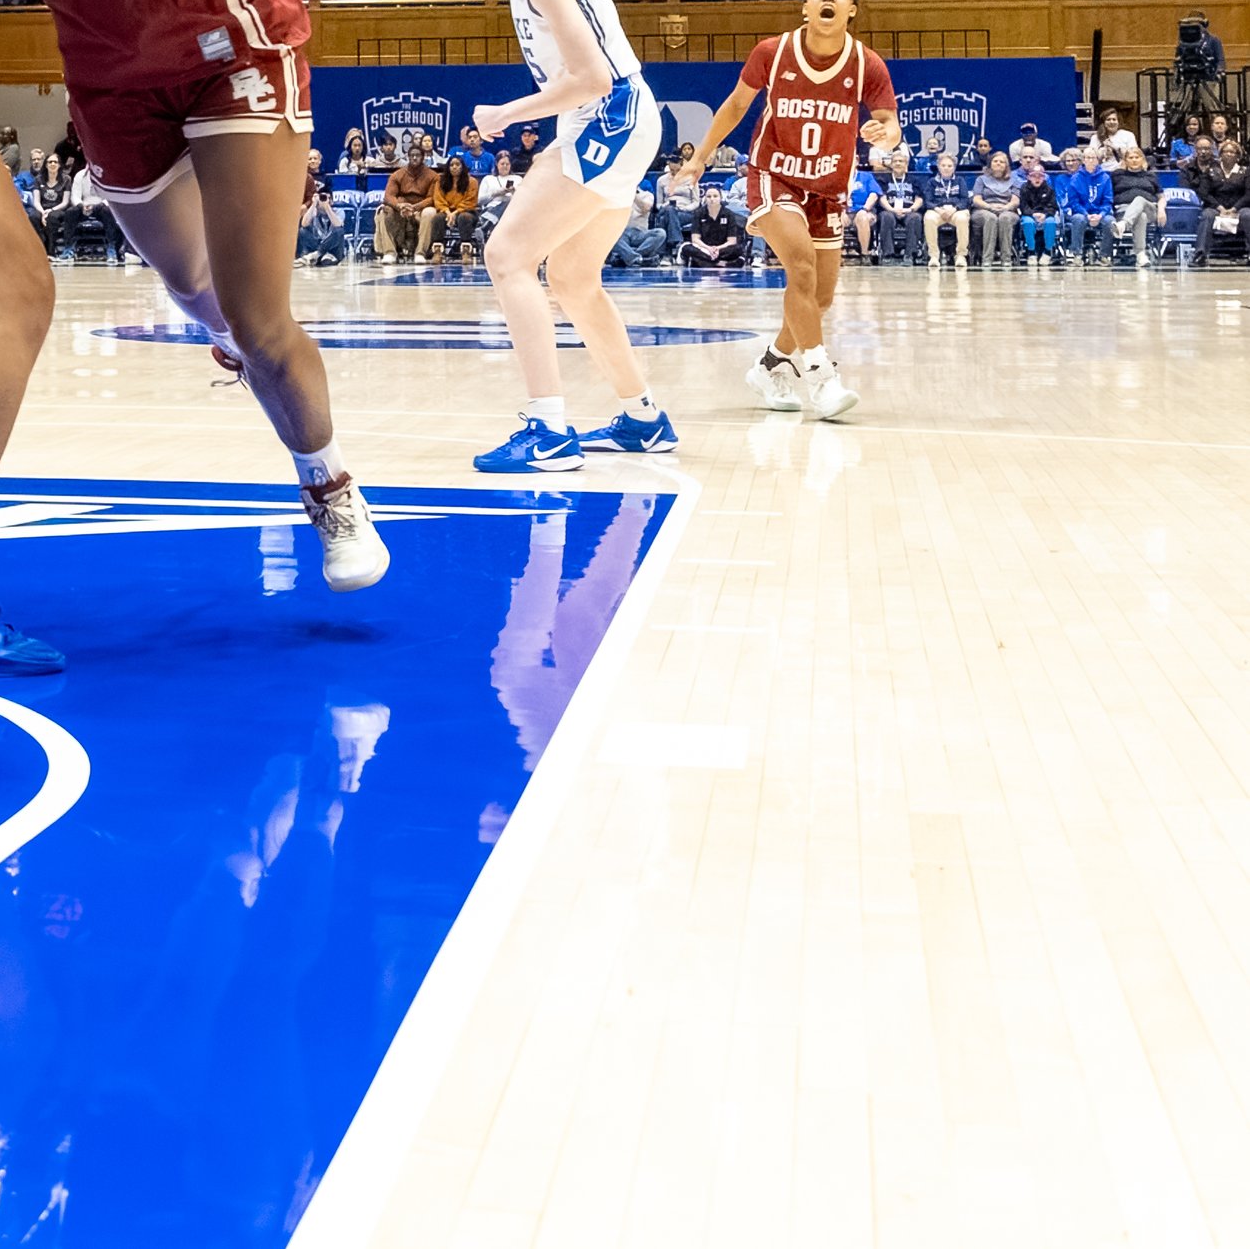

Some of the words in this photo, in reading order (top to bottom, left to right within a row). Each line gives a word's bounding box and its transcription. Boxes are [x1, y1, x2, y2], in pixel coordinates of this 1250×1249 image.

[371, 110, 443, 131] SISTERHOOD
[777, 98, 853, 124] BOSTON
[900, 107, 979, 127] SISTERHOOD
[801, 122, 822, 156] 0
[769, 152, 842, 180] COLLEGE
